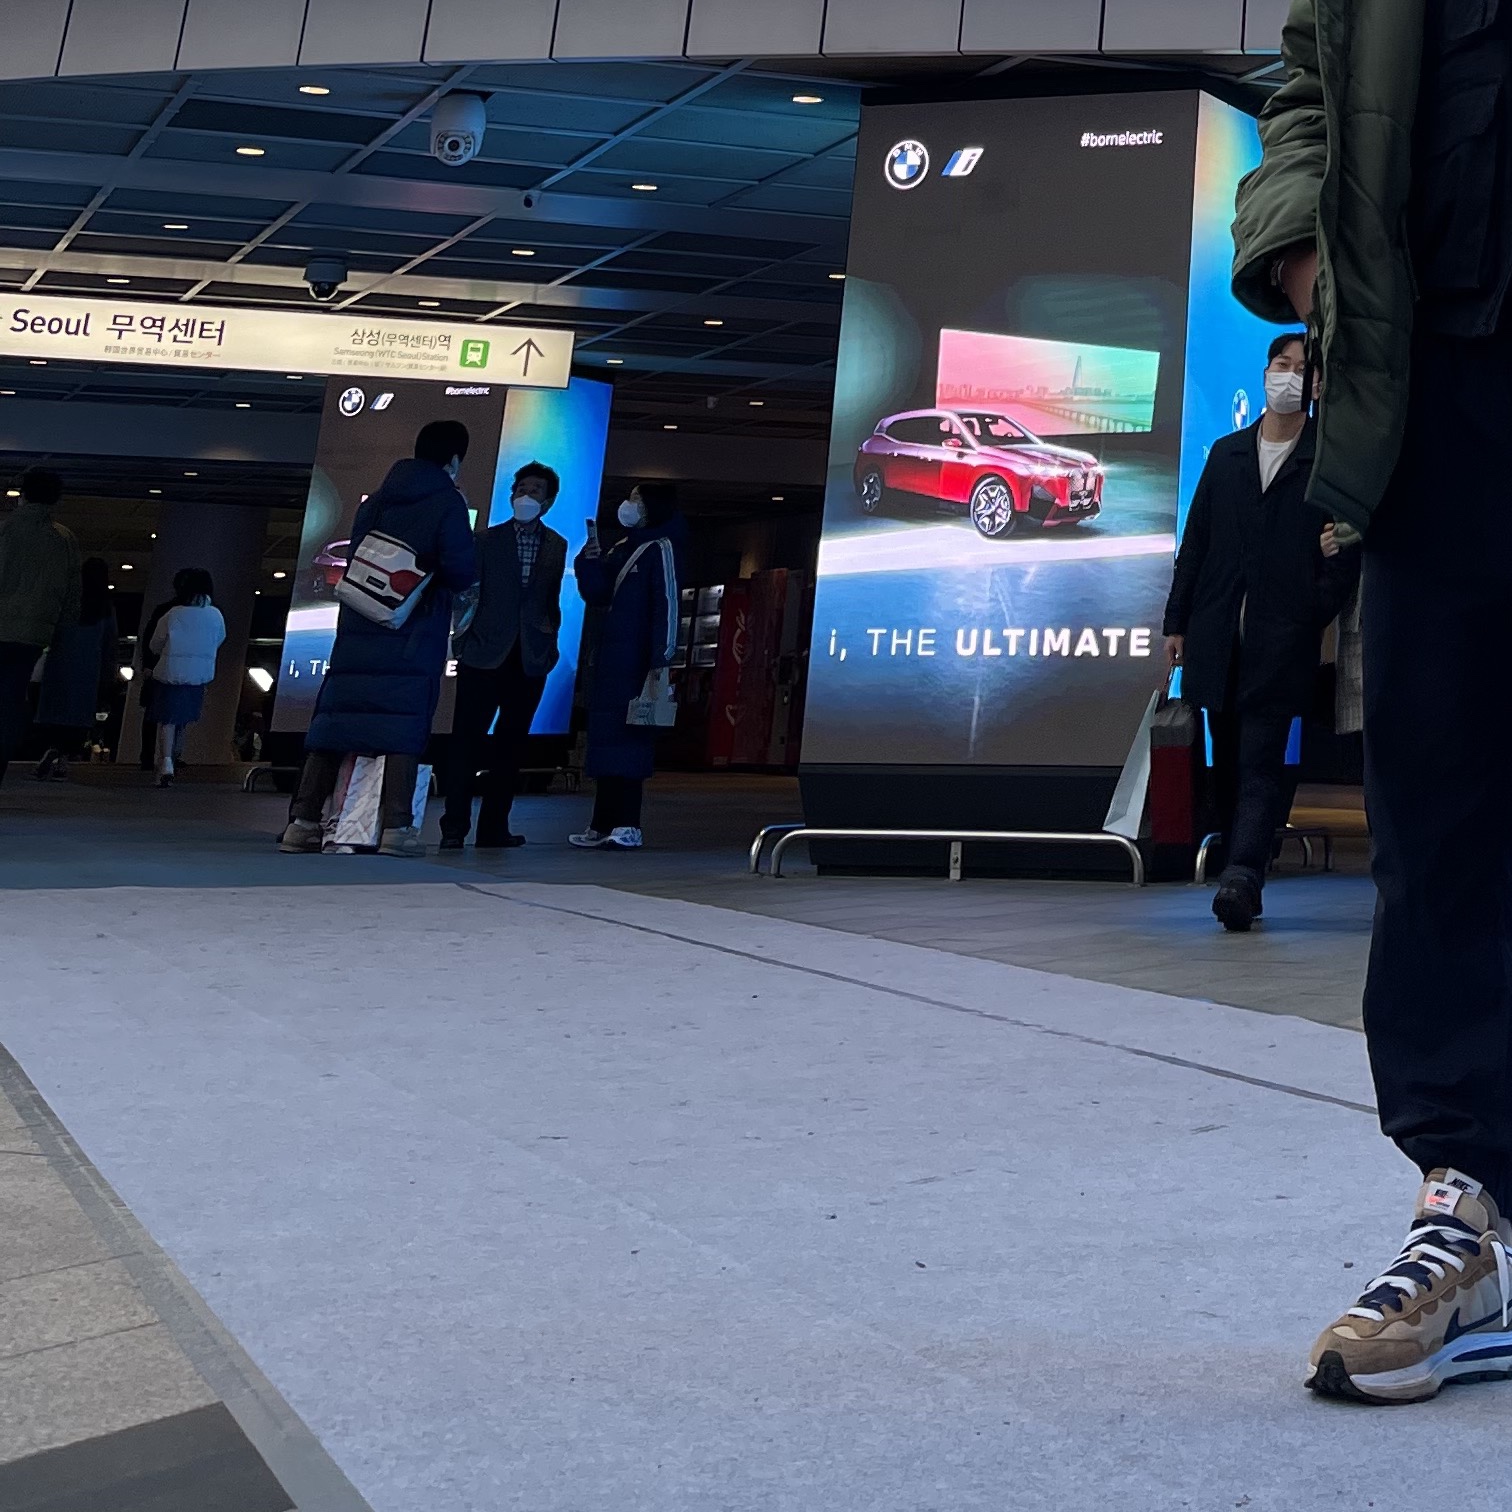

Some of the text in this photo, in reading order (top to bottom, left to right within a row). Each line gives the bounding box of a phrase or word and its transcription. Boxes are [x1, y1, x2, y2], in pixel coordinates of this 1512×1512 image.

[1080, 129, 1164, 148] #bornelectric
[9, 308, 226, 346] Seoul 무역센터
[350, 328, 451, 352] 삼성(무역센터)역
[866, 628, 937, 656] THE
[956, 627, 1151, 657] ULTIMATE
